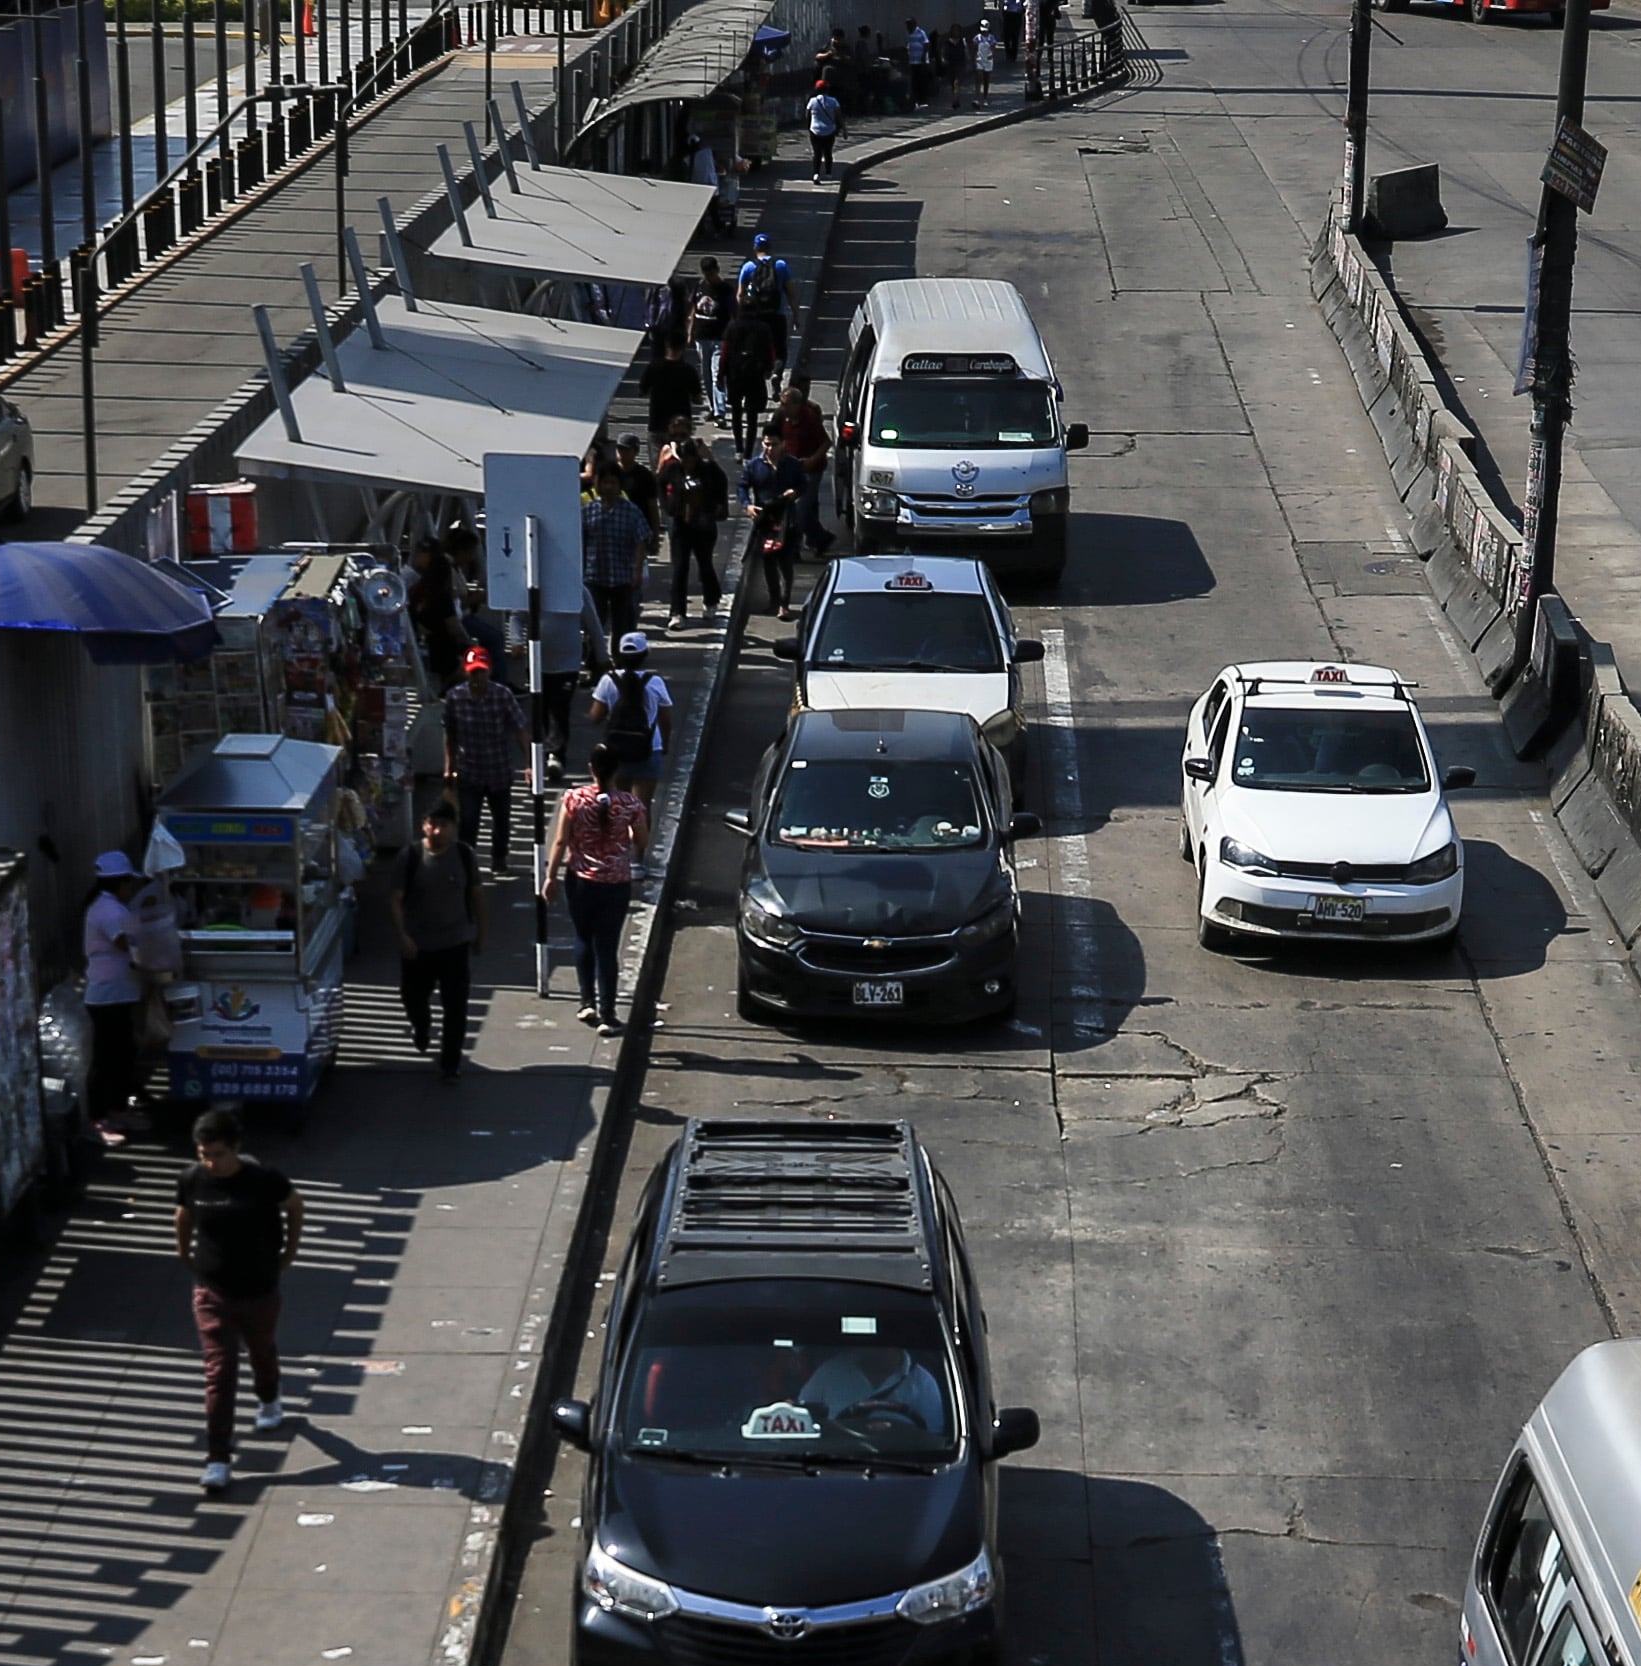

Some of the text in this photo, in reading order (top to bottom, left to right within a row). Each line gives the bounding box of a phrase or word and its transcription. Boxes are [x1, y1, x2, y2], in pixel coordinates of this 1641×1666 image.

[904, 358, 944, 371] Callao
[898, 575, 923, 586] TAXI
[1316, 670, 1344, 682] TAXI
[1316, 898, 1361, 919] AHV-520
[760, 1414, 806, 1434] TAXI
